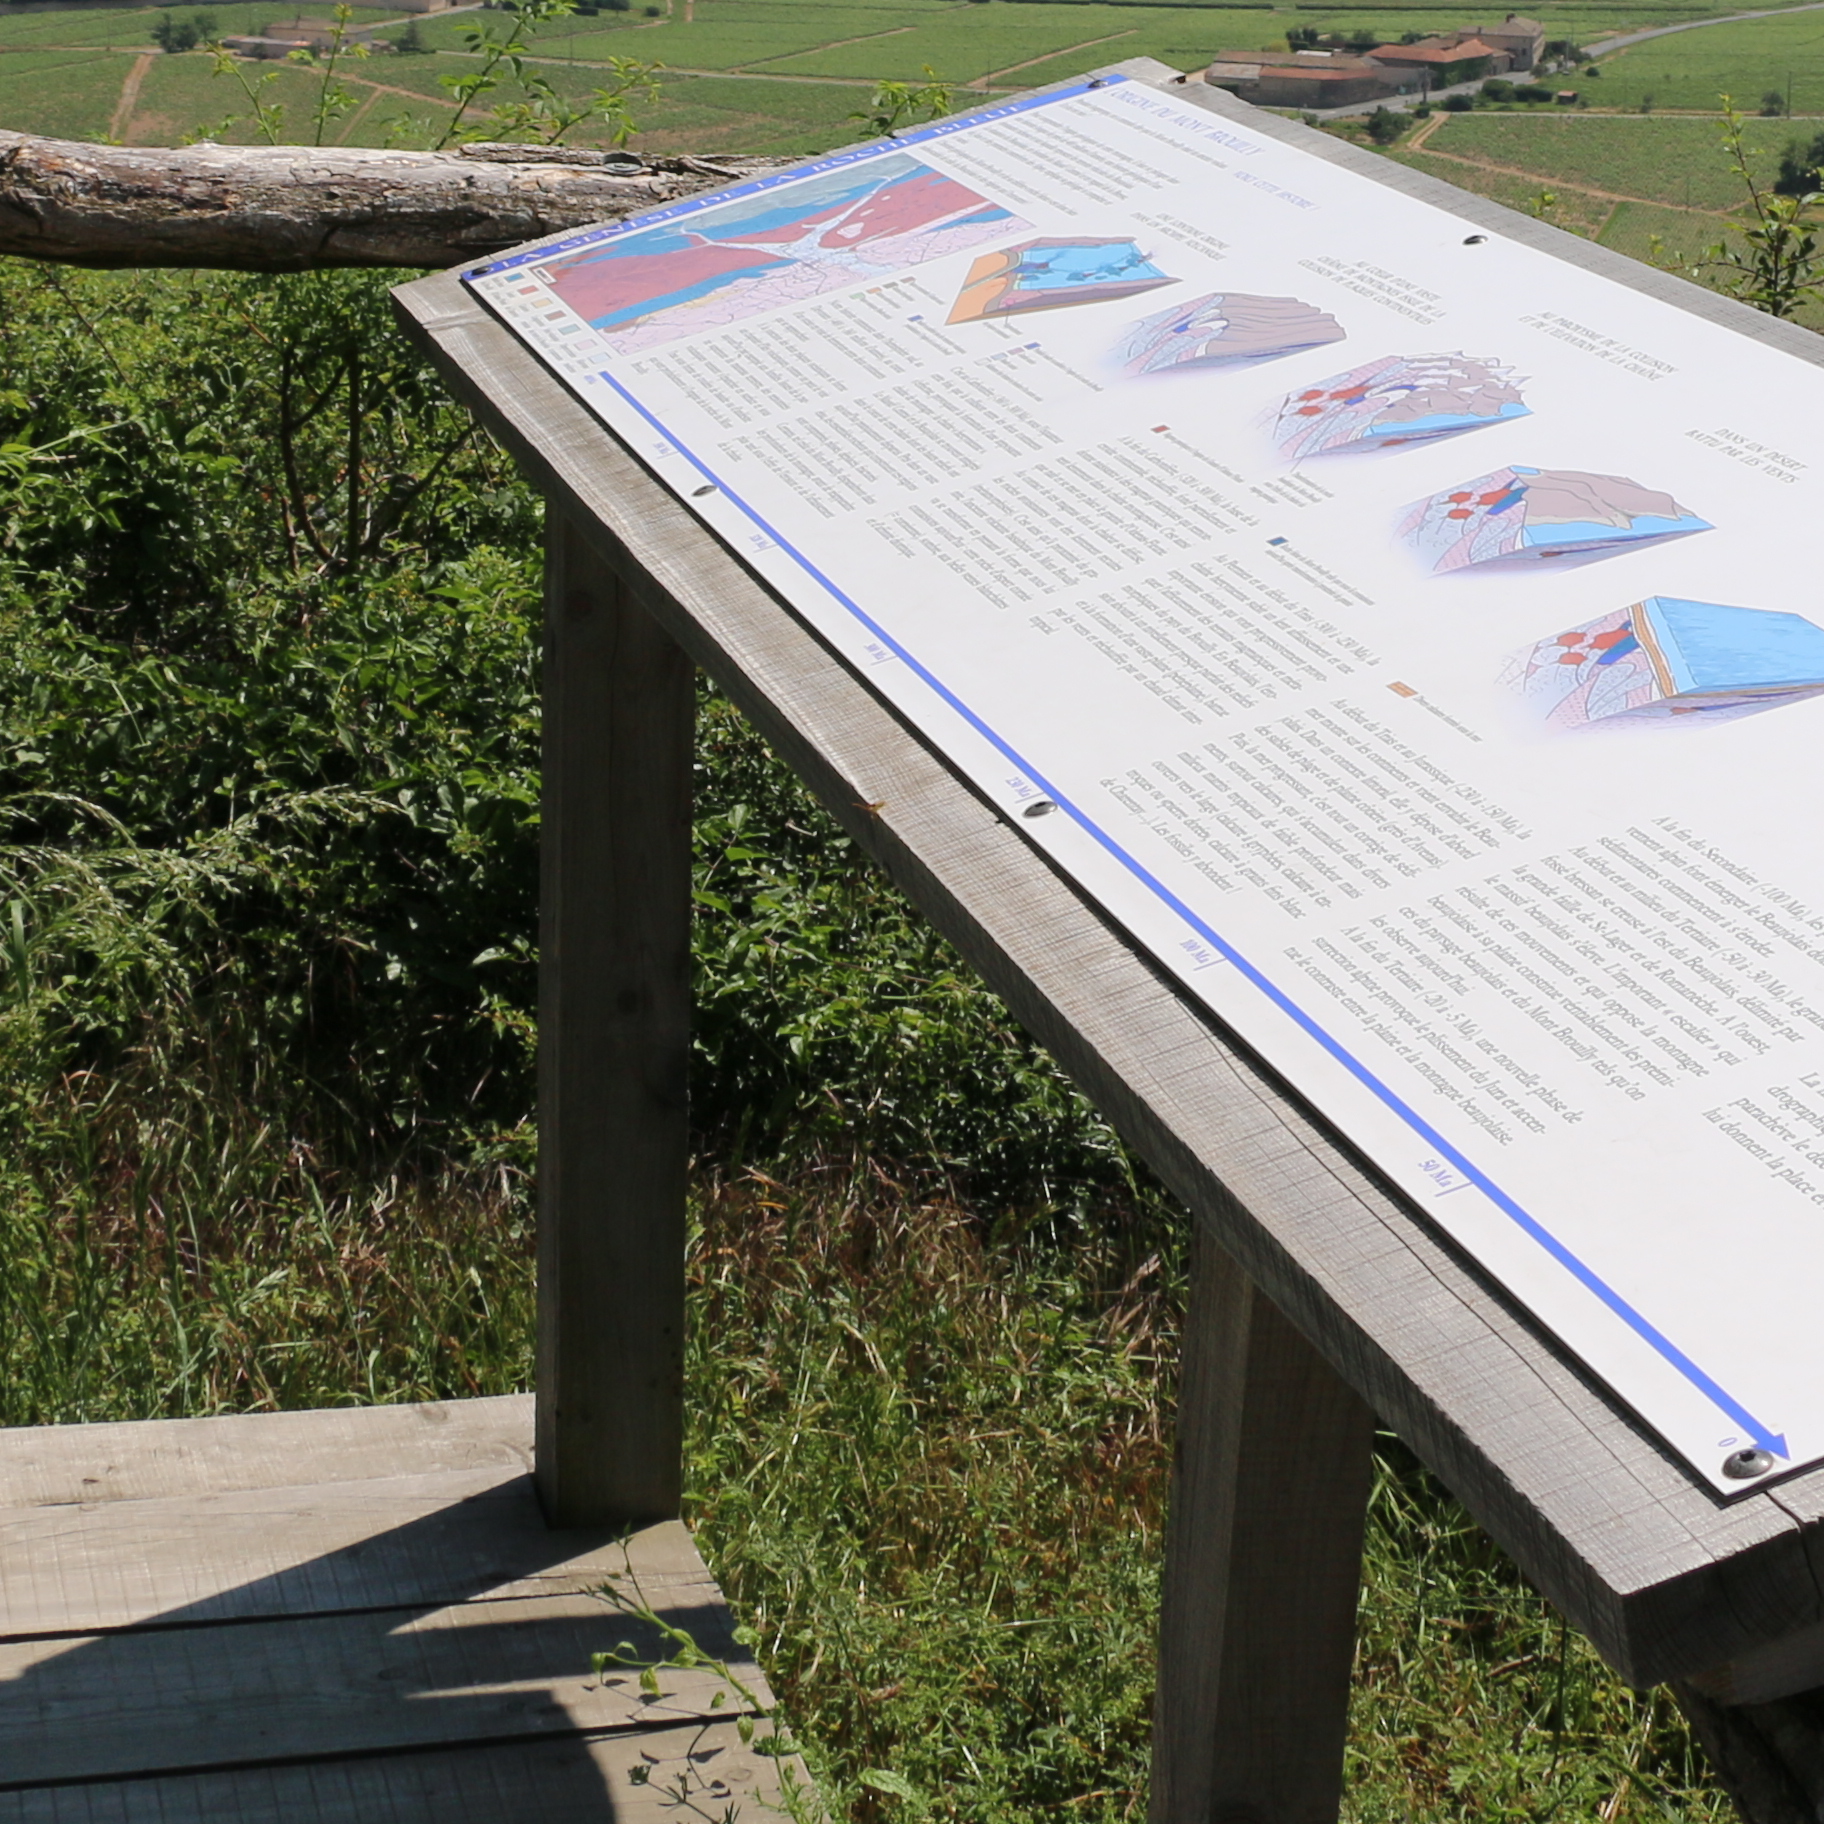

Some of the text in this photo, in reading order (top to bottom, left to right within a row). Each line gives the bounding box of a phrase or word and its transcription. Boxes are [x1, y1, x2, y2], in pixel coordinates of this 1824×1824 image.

[1685, 430, 1800, 483] BATTU PAR LES VENTS
[1714, 429, 1808, 471] DANS UN DÉSERT
[1180, 939, 1210, 963] 100 Ma
[1798, 1072, 1820, 1088] La
[1702, 1107, 1731, 1123] lui
[1727, 1098, 1796, 1141] parachève
[1791, 1139, 1810, 1151] le
[1719, 1122, 1773, 1160] donnent
[1418, 1160, 1452, 1187] 50 Ma
[1765, 1156, 1785, 1170] la
[1770, 1169, 1815, 1194] place
[1718, 1437, 1737, 1447] 0
